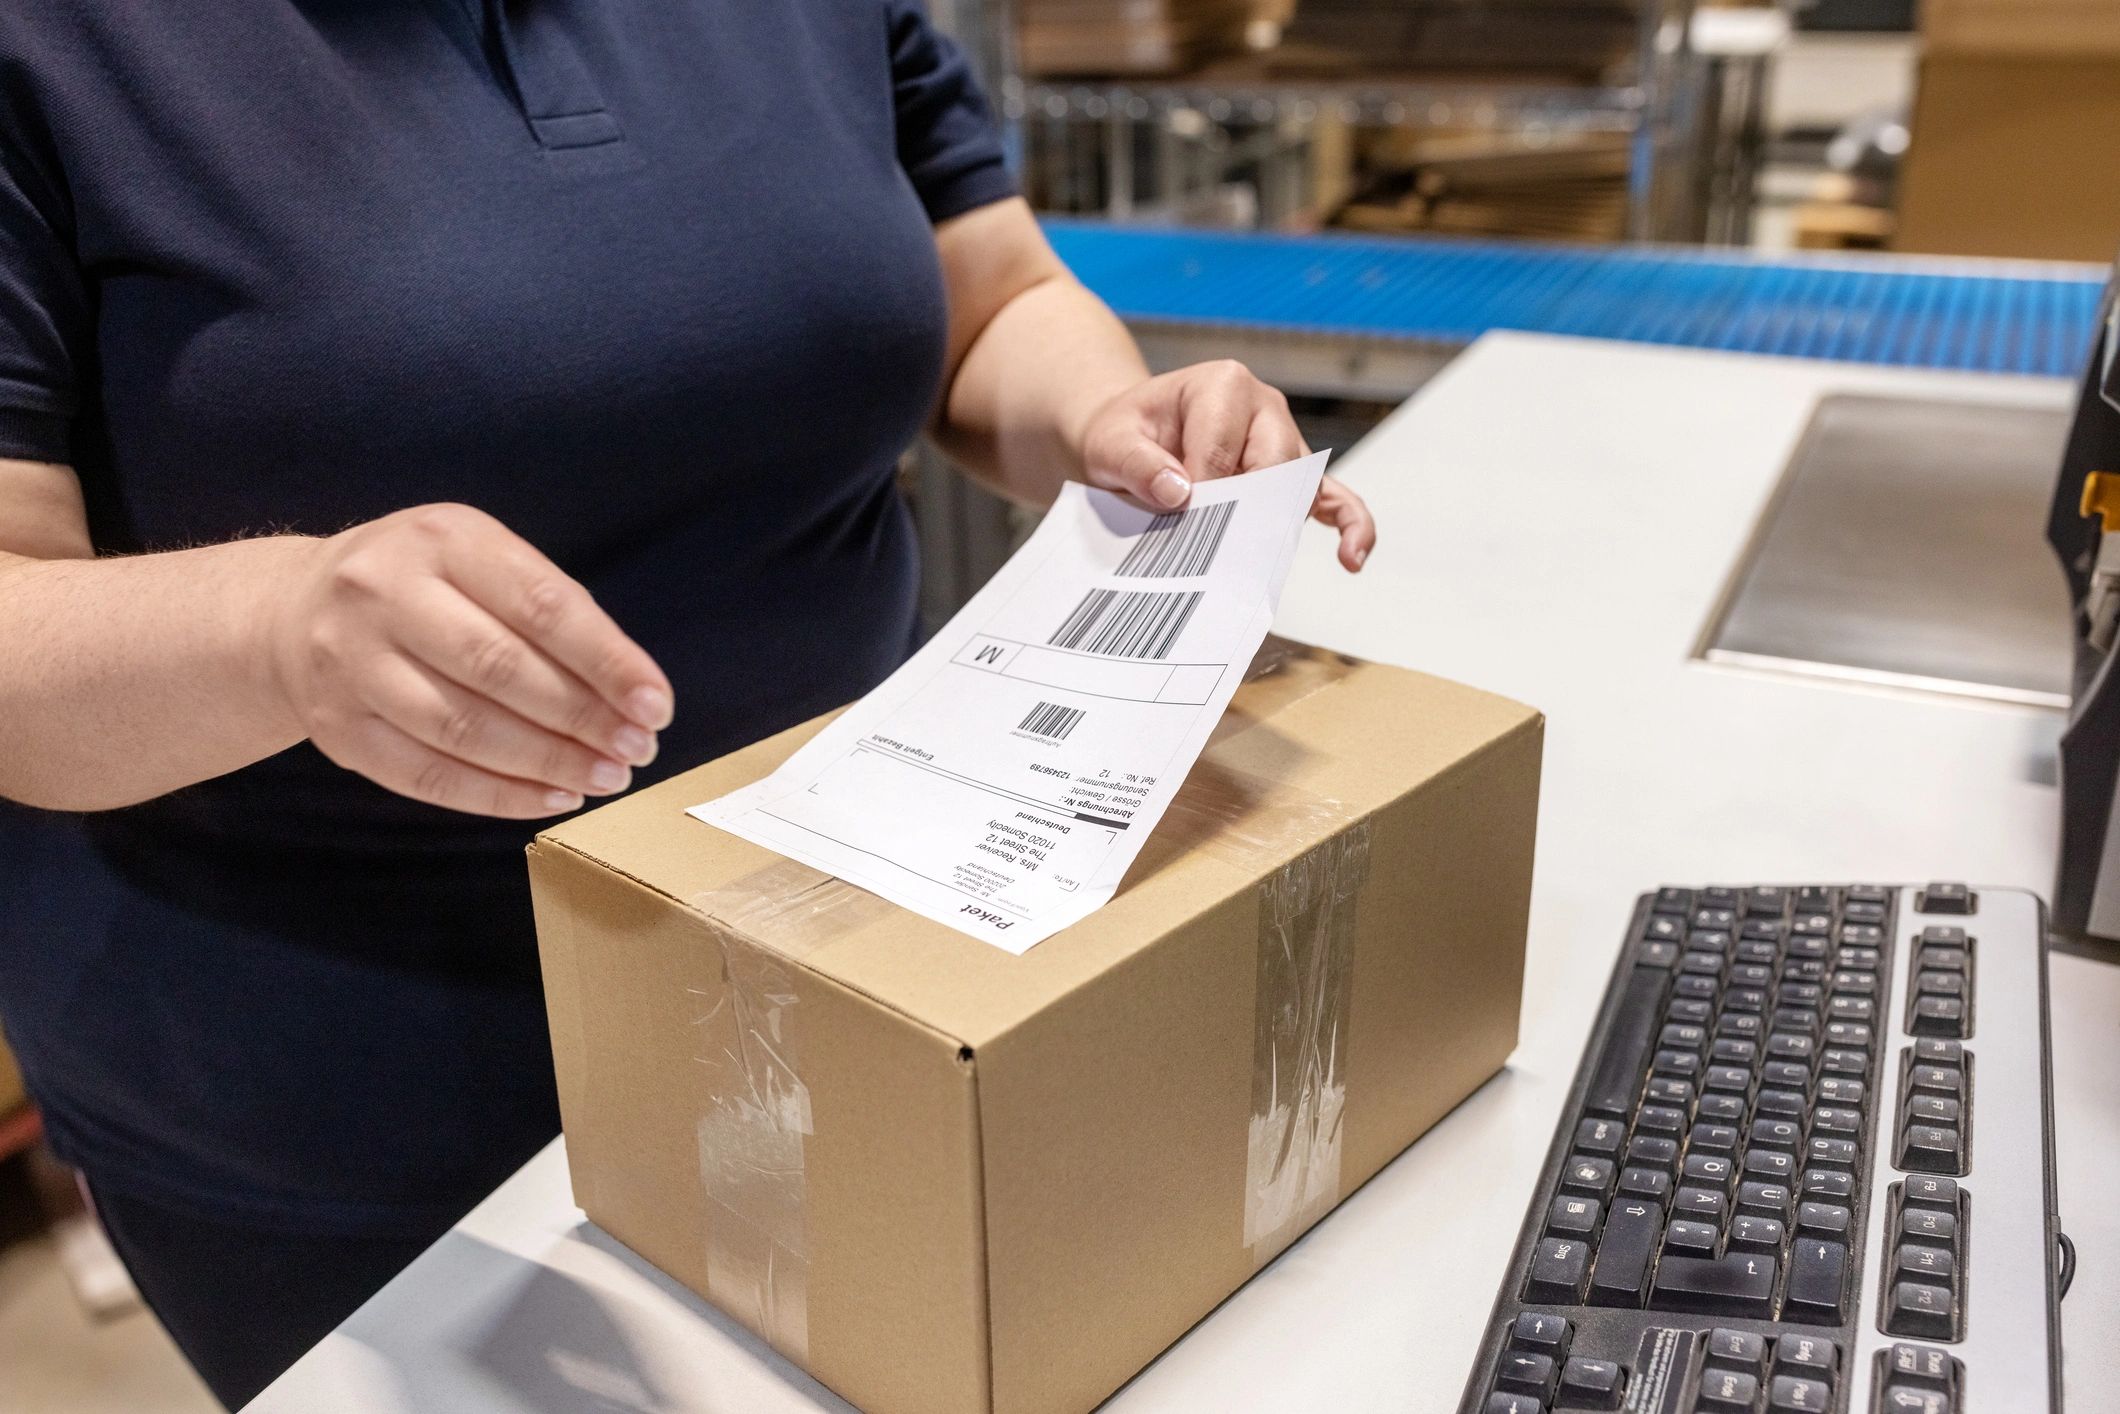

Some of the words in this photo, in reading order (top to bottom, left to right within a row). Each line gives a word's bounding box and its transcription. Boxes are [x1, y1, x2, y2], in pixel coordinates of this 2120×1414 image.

[974, 644, 1004, 664] M
[871, 733, 902, 750] Bezahlt
[903, 742, 934, 761] Entgelt
[1029, 763, 1071, 780] 123456789
[1098, 769, 1111, 779] 12
[1142, 775, 1157, 786] Ref.
[1111, 795, 1142, 808] Grösse
[1077, 800, 1135, 819] Abrechnungs
[986, 819, 1028, 840] Somecity
[1015, 811, 1071, 835] Deutschland
[985, 833, 998, 843] 12
[1027, 834, 1056, 850] 11020
[1000, 838, 1028, 854] Street
[975, 843, 1017, 863] Receiver
[1028, 848, 1047, 862] The
[1019, 858, 1039, 872] Mrs.
[966, 861, 1015, 885] Deutschland
[985, 885, 998, 893] The
[960, 904, 1015, 930] Paket
[1726, 1071, 1743, 1081] J
[1783, 1067, 1799, 1076] U
[1667, 1082, 1684, 1094] M
[1719, 1099, 1736, 1109] K
[1932, 1100, 1943, 1110] F7
[1818, 1109, 1832, 1118] 9
[1711, 1129, 1729, 1137] L
[1774, 1125, 1791, 1135] O
[1930, 1132, 1941, 1141] F8
[1703, 1161, 1724, 1172] Ö
[1770, 1155, 1786, 1166] P
[1924, 1181, 1937, 1191] F9
[1697, 1193, 1716, 1203] Ä
[1761, 1189, 1781, 1199] Ü
[1923, 1215, 1936, 1229] F10
[1554, 1243, 1571, 1260] Strg
[1921, 1252, 1934, 1265] F11
[1918, 1290, 1932, 1305] F12
